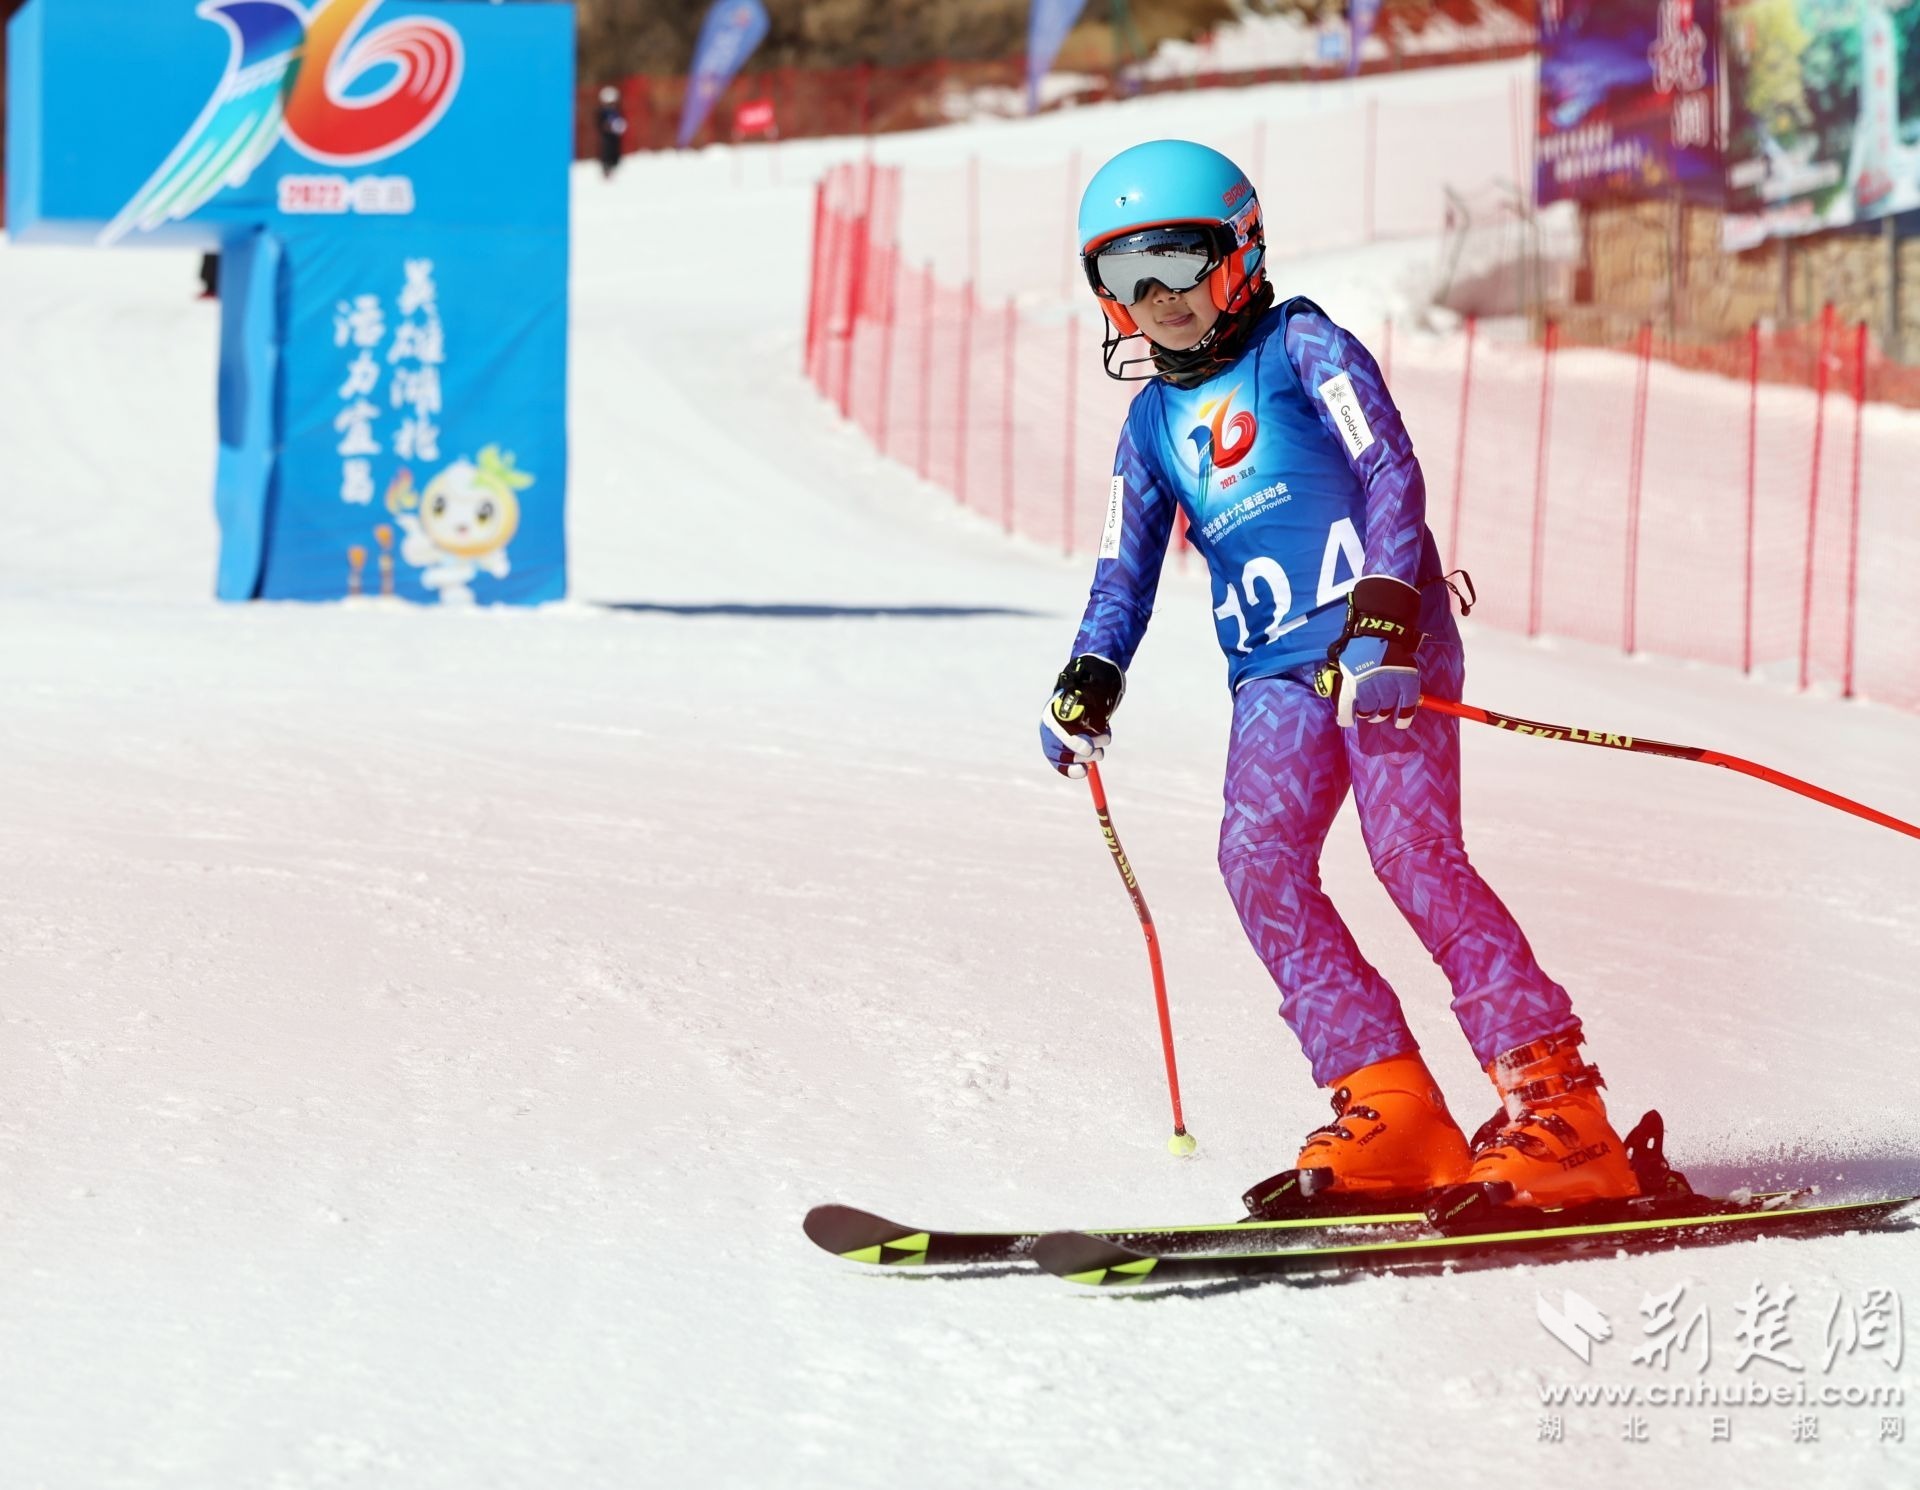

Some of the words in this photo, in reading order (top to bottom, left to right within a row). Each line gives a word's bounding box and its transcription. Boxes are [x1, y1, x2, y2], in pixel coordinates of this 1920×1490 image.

[1340, 404, 1363, 450] Goldwin
[1242, 508, 1262, 523] Hubei
[1262, 494, 1293, 512] Province
[1360, 617, 1405, 636] LEKI
[1355, 660, 1375, 672] WEDZE
[1570, 727, 1633, 748] LEKI
[1357, 1123, 1387, 1146] TECNICA
[1558, 1141, 1611, 1172] TECNICA
[1260, 1177, 1297, 1205] FISCHER
[1444, 1191, 1480, 1220] FISCHER
